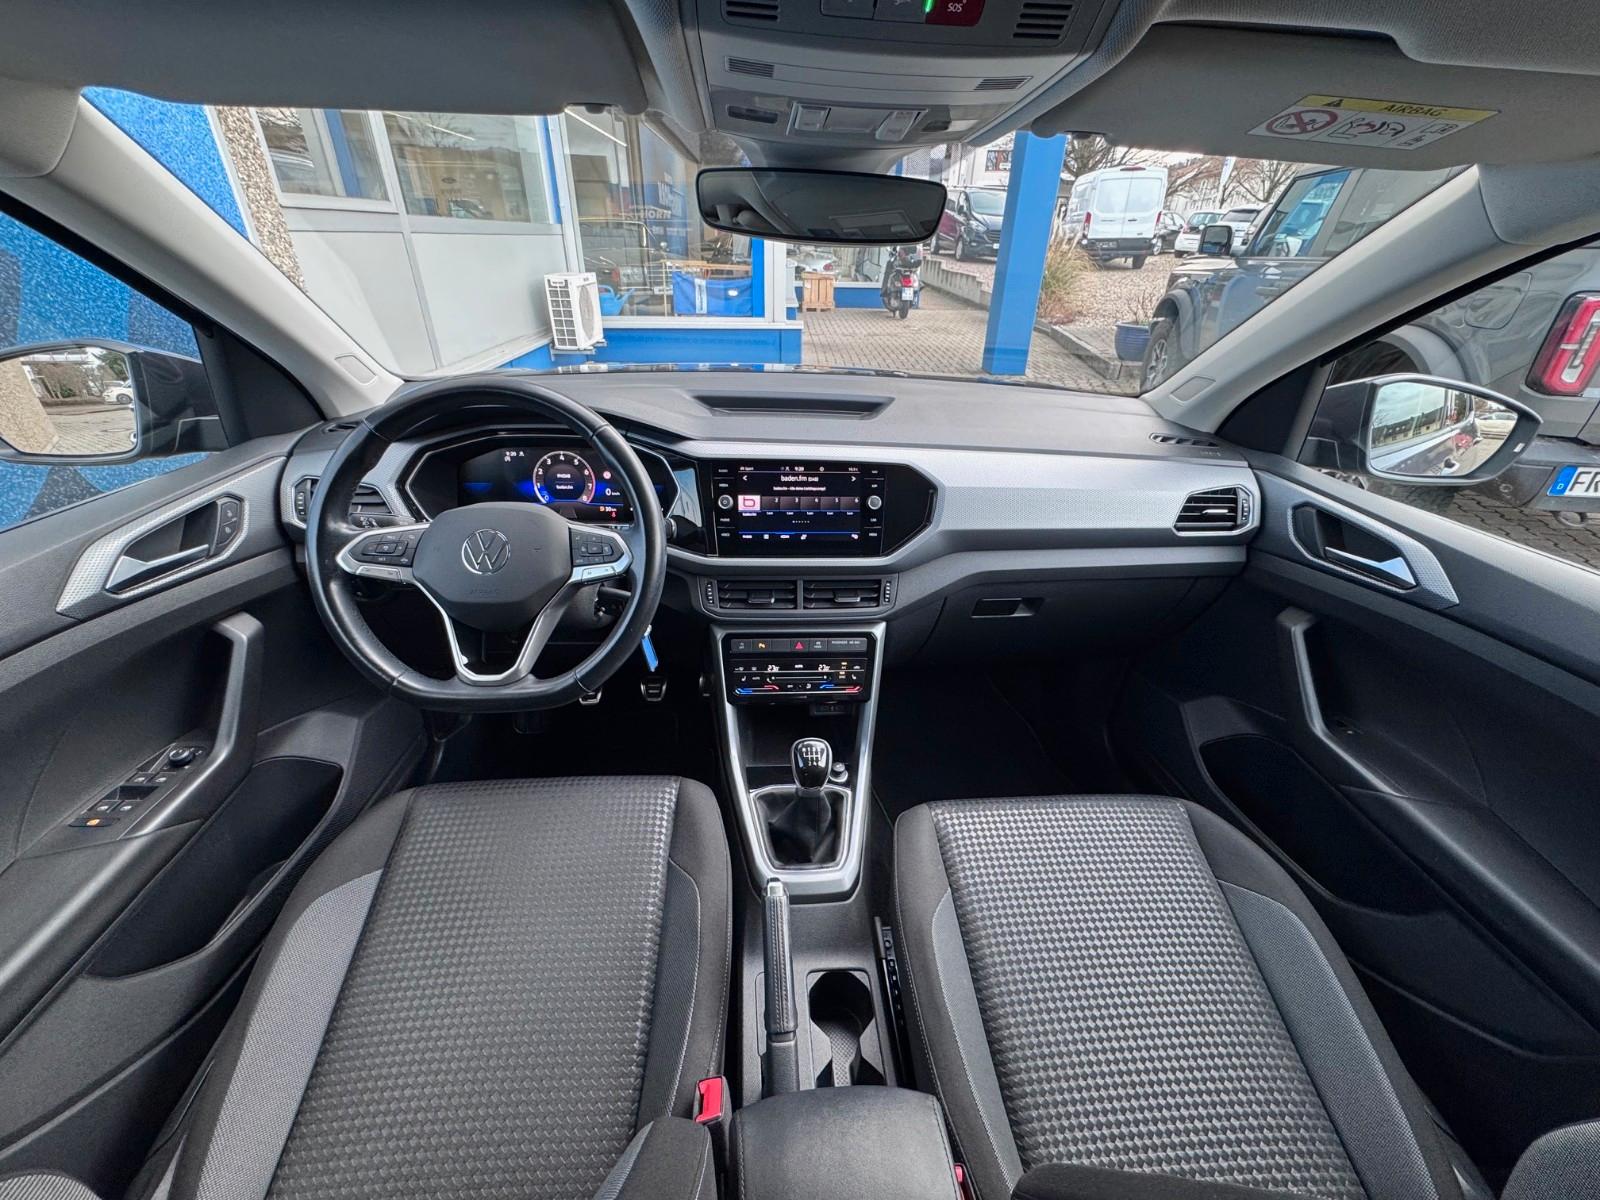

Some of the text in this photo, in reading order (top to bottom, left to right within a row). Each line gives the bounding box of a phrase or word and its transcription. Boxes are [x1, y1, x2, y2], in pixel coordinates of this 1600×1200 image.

[947, 2, 964, 12] SOS
[1383, 104, 1448, 117] AIRBAG
[605, 487, 612, 496] 0
